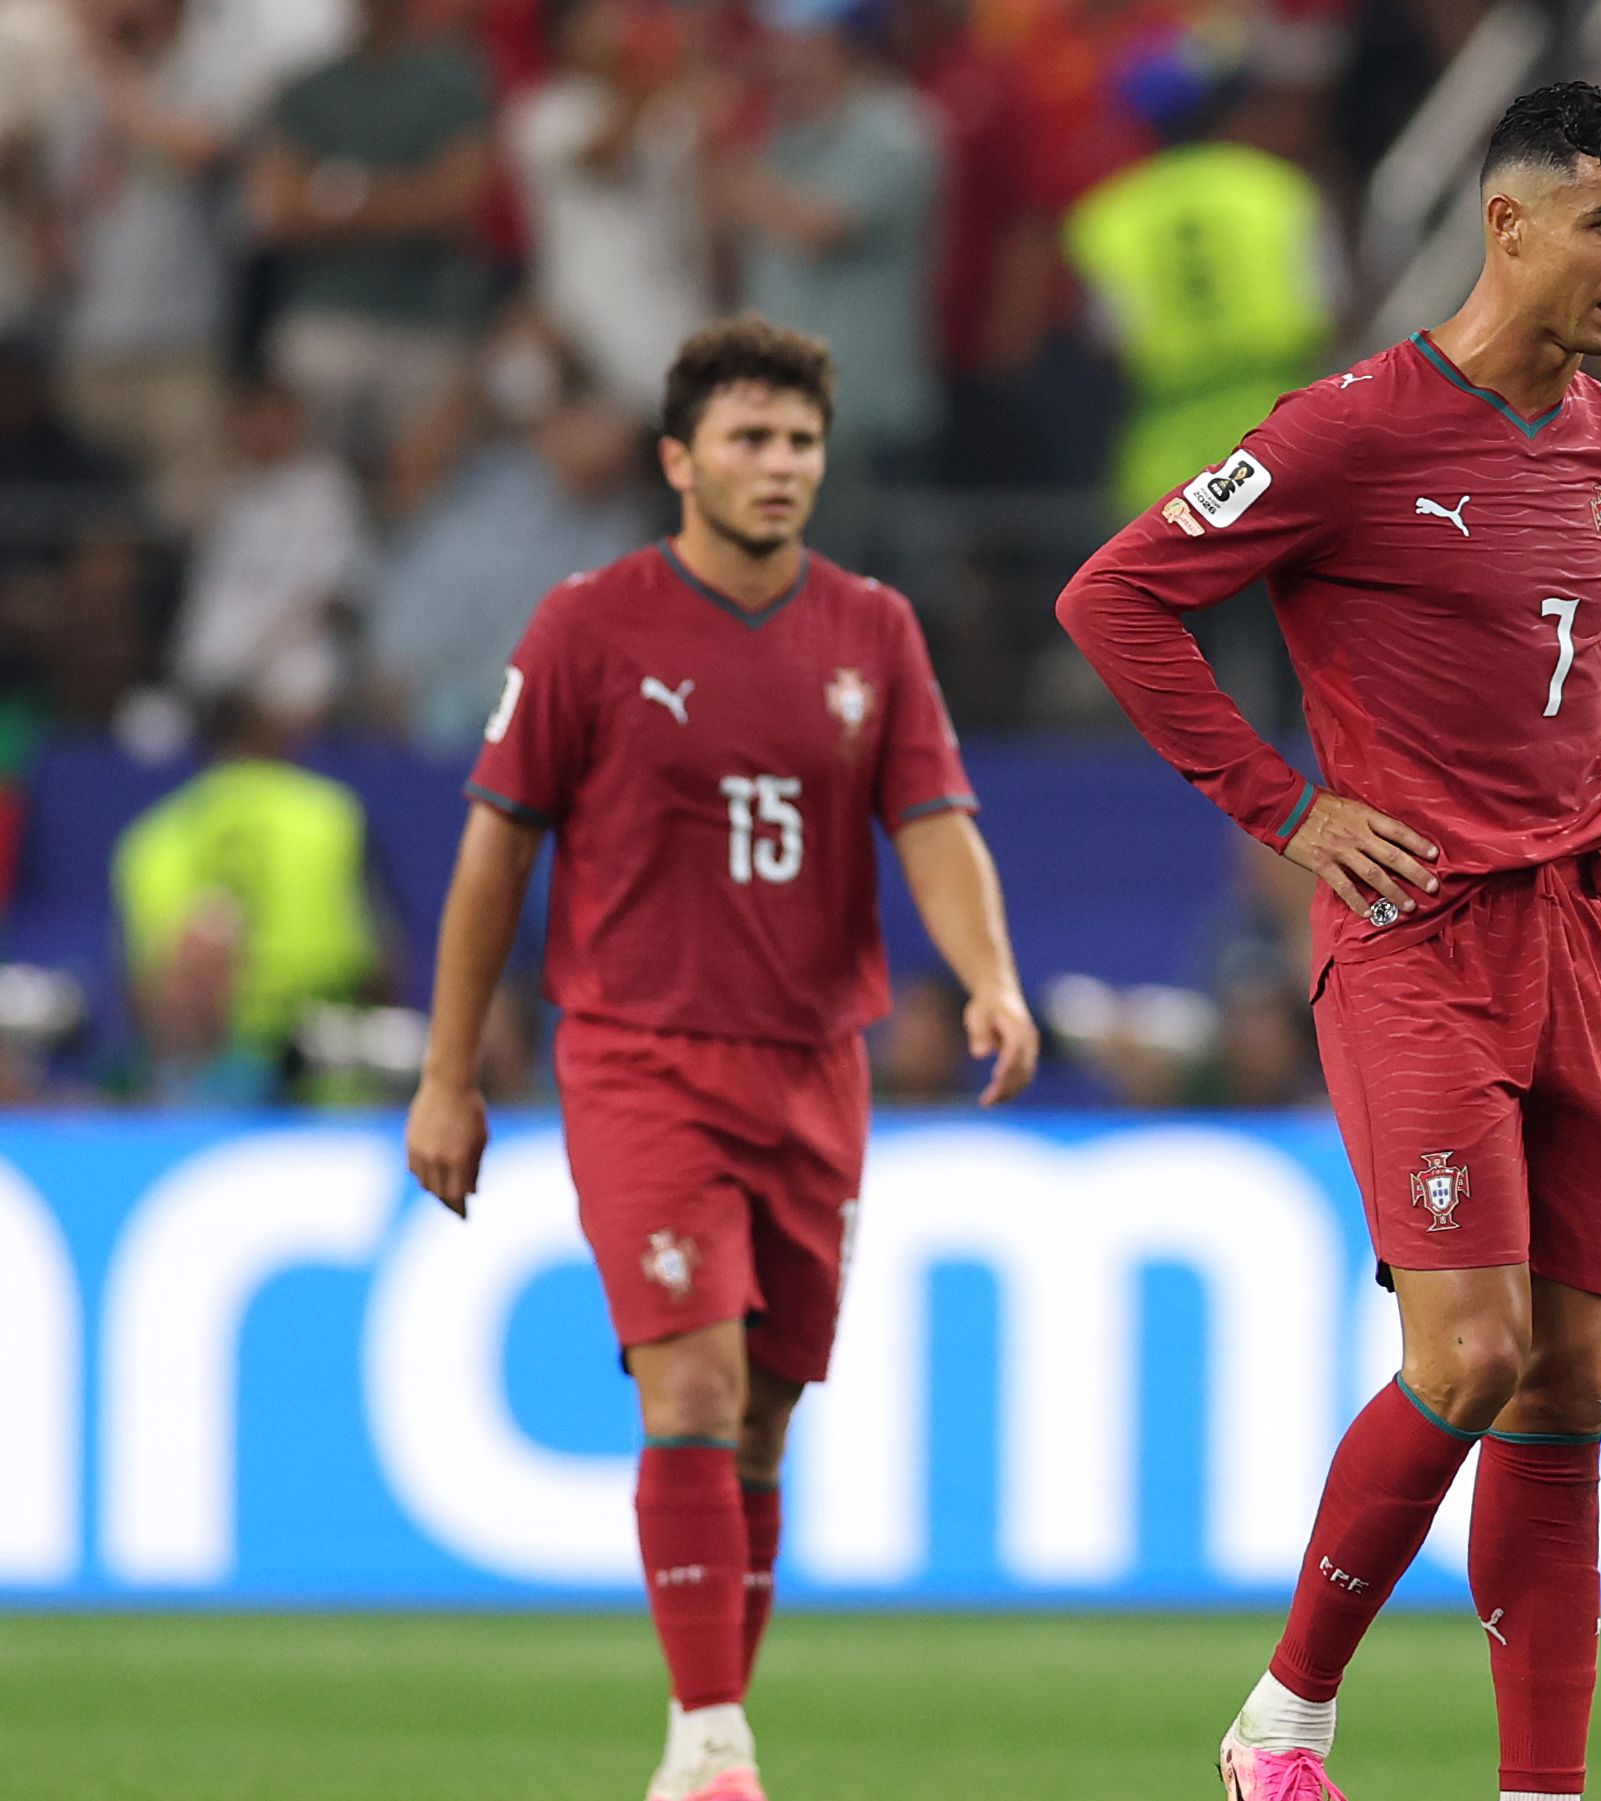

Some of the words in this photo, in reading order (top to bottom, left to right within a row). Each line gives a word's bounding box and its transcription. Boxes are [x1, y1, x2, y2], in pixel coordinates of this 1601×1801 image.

[1193, 491, 1217, 515] 2026
[1541, 598, 1581, 717] 7
[718, 773, 803, 885] 15
